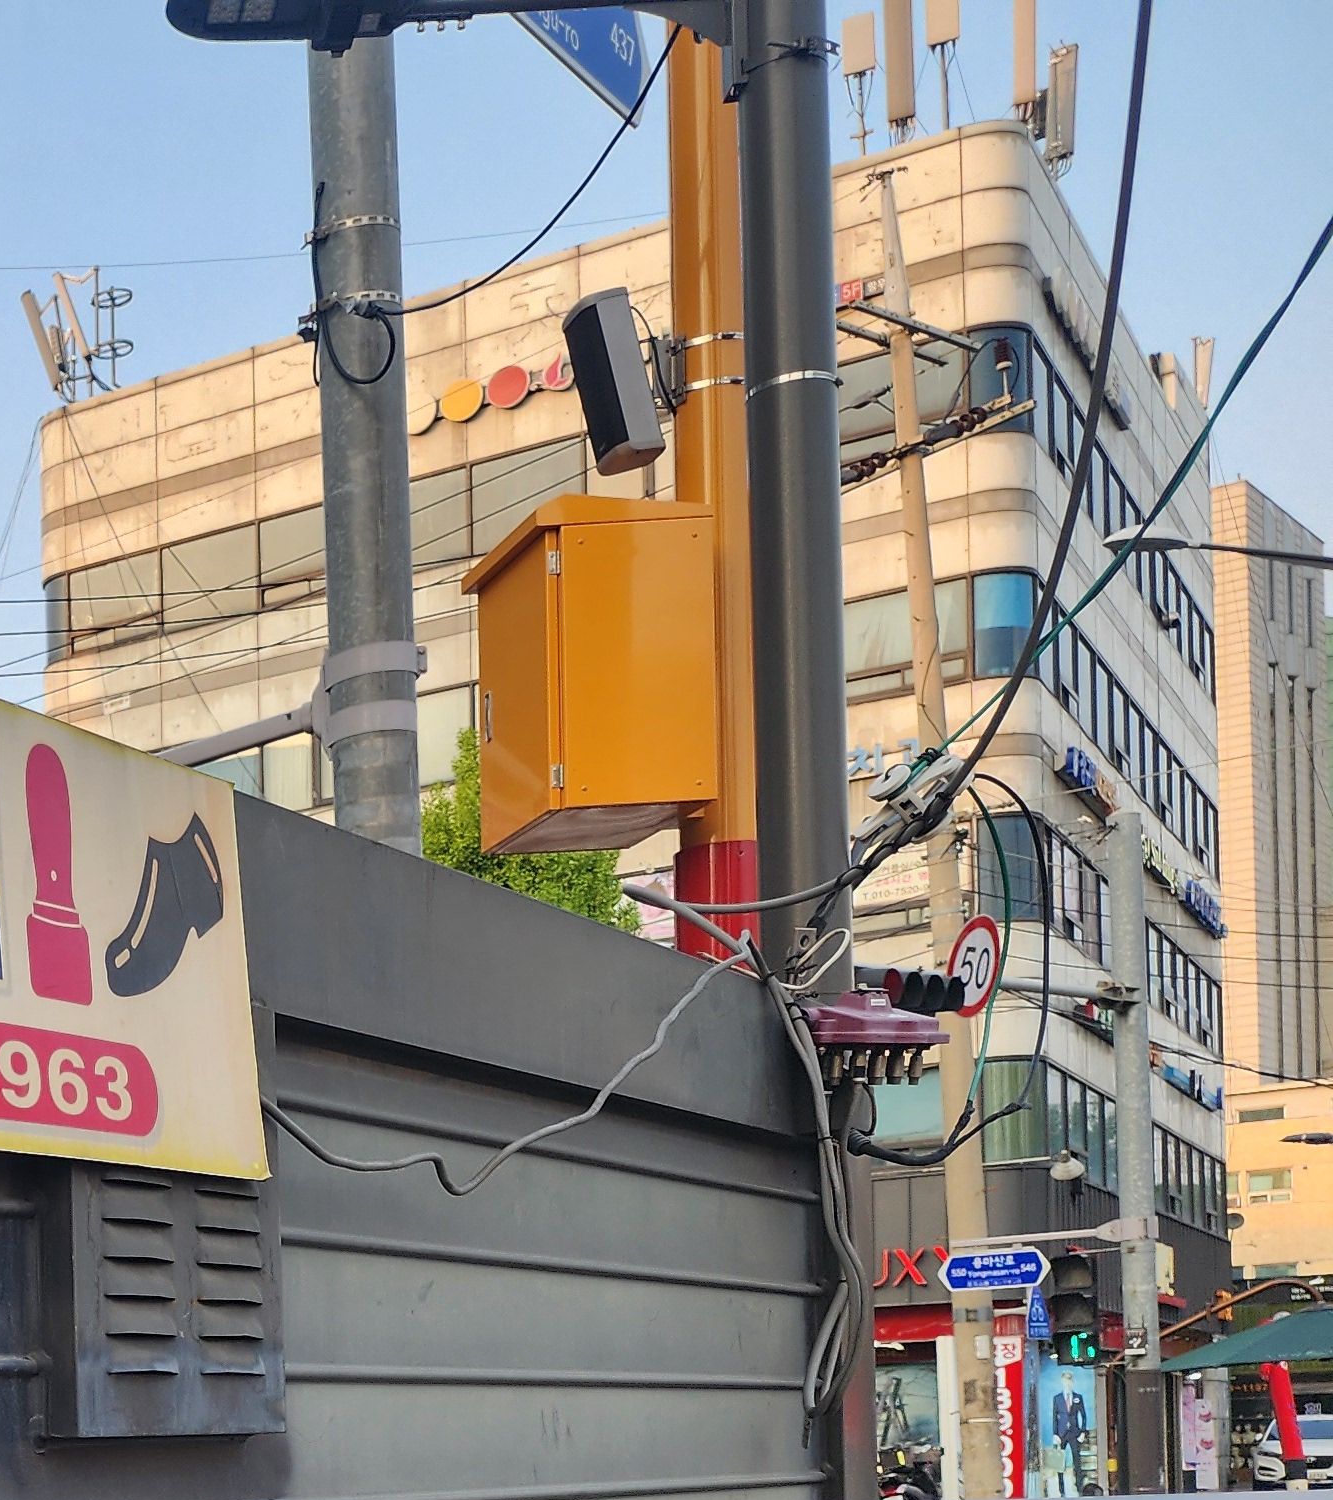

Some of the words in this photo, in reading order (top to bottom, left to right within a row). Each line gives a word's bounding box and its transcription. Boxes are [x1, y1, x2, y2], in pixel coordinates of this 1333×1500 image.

[537, 10, 579, 51] gu-ro
[610, 22, 635, 66] 437
[960, 946, 990, 990] 50
